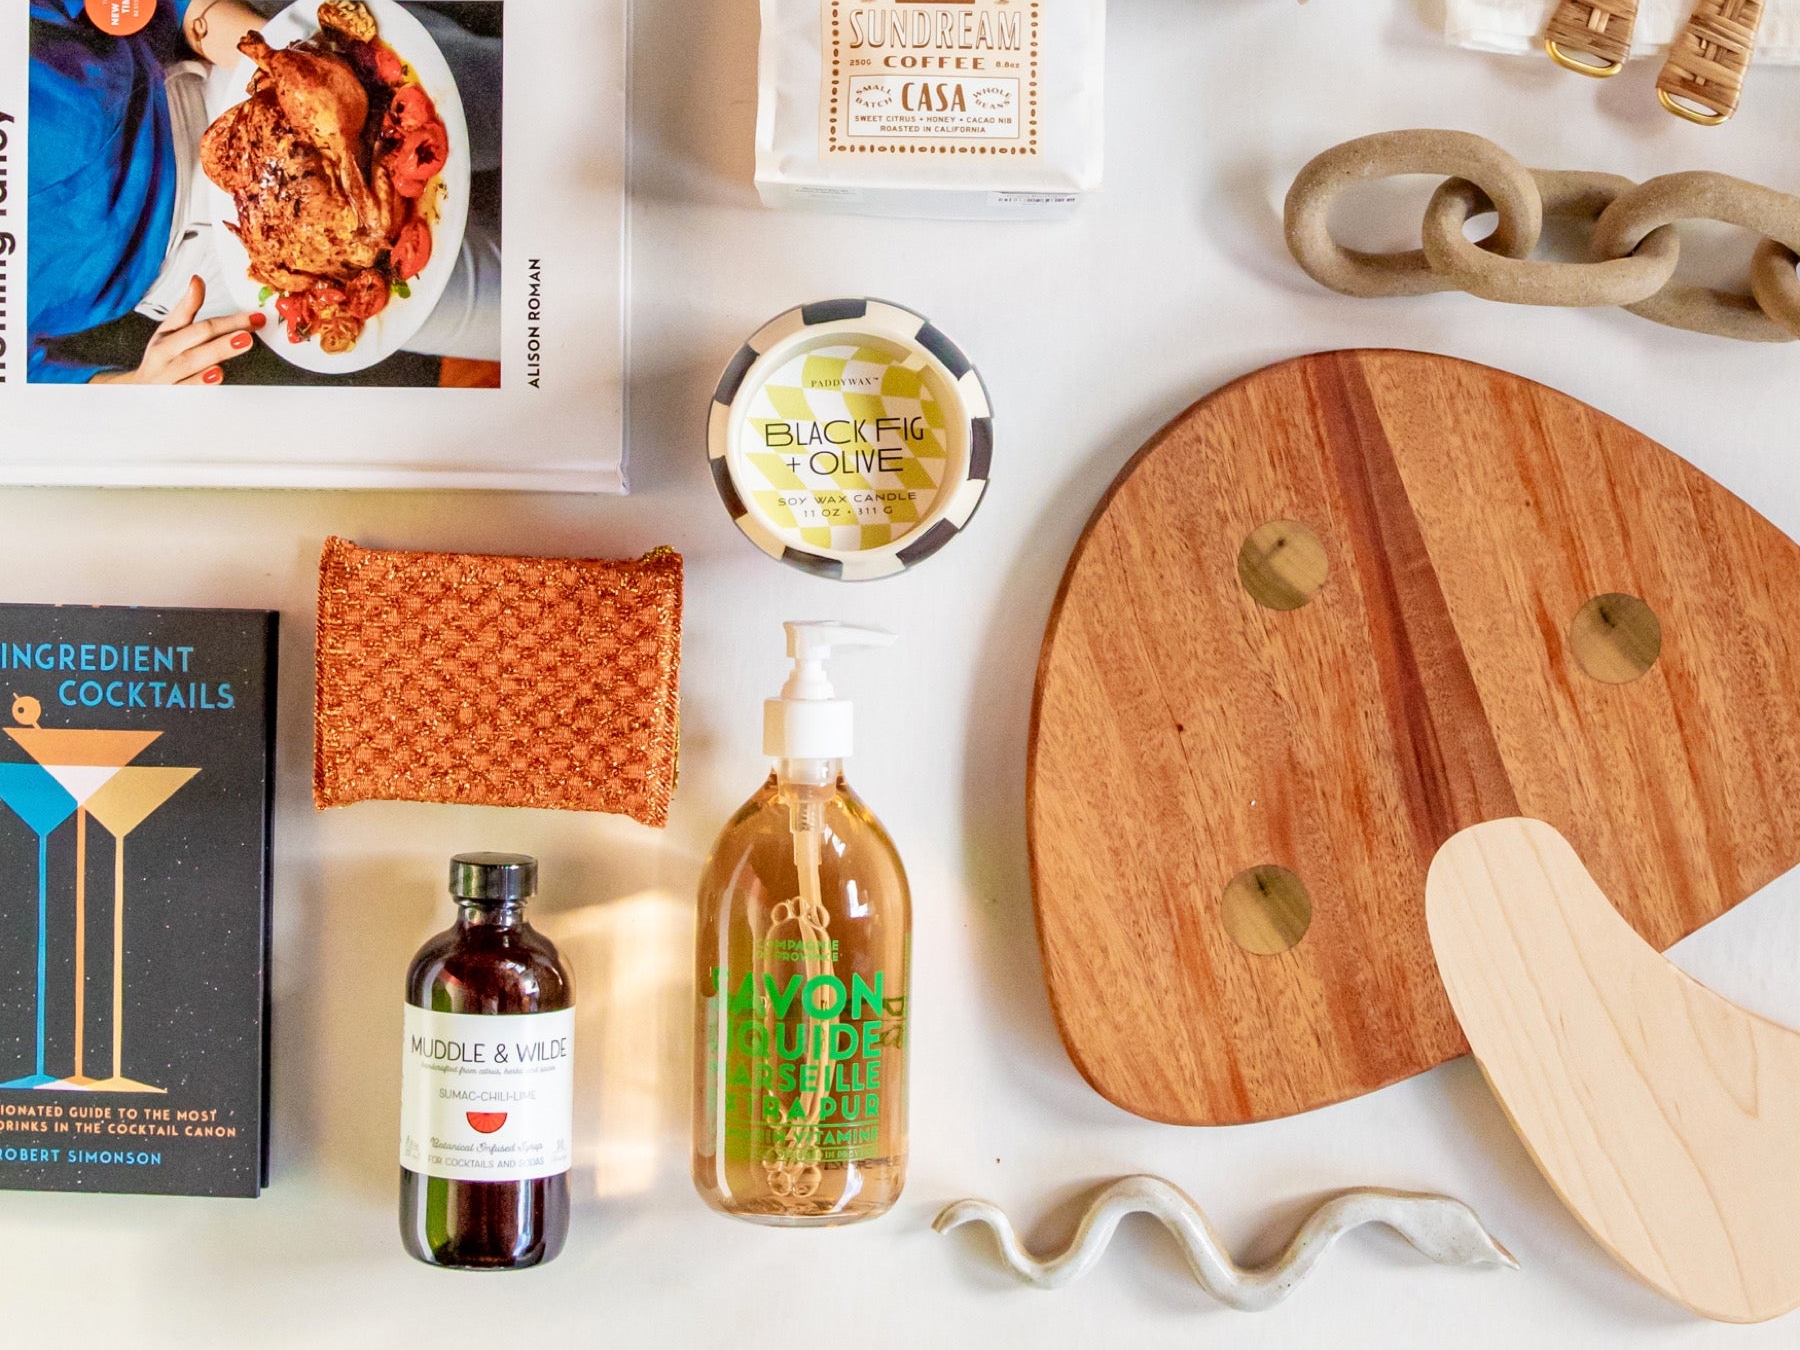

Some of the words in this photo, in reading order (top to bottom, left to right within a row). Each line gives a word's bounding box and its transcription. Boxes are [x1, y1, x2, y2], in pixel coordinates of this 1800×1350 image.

[111, 3, 120, 26] NEW
[849, 9, 1022, 51] SUNDREAM
[883, 55, 985, 70] COFFEE
[855, 84, 893, 95] SMALL
[901, 82, 967, 112] CASA
[972, 87, 1012, 99] WHOLE
[855, 97, 893, 108] BATCH
[975, 98, 1011, 110] BEANS
[855, 115, 883, 123] SWEET
[886, 115, 916, 123] CITRUS
[966, 116, 995, 124] CACAO
[880, 125, 920, 133] ROASTED
[528, 259, 541, 321] ROMAN
[527, 326, 540, 389] ALISON
[765, 419, 868, 447] BLACK
[876, 416, 924, 442] FIG
[809, 447, 904, 476] OLIVE
[777, 497, 807, 507] SOY
[814, 495, 848, 505] WAX
[853, 491, 917, 503] CANDLE
[803, 509, 815, 517] 11
[821, 508, 841, 517] OZ
[858, 506, 877, 516] 311
[883, 505, 893, 515] G
[1, 642, 194, 673] INGREDIENT
[58, 679, 235, 709] COCKTAILS
[411, 1034, 486, 1063] MUDDLE
[494, 1043, 509, 1064] &
[516, 1037, 567, 1063] WILDE
[708, 1060, 881, 1092] ARSEILLE
[69, 1106, 112, 1119] GUIDE
[117, 1107, 139, 1120] TO
[144, 1108, 171, 1121] THE
[176, 1109, 217, 1122] MOST
[819, 1093, 880, 1121] PUR
[54, 1121, 69, 1132] IN
[75, 1122, 101, 1134] THE
[107, 1123, 179, 1137] COCKTAIL
[184, 1125, 237, 1137] CANON
[0, 1148, 60, 1162] OBERT
[68, 1150, 162, 1165] SIMONSON
[428, 1155, 442, 1165] FOR
[445, 1157, 495, 1169] COCKTAILS
[497, 1159, 516, 1169] AND
